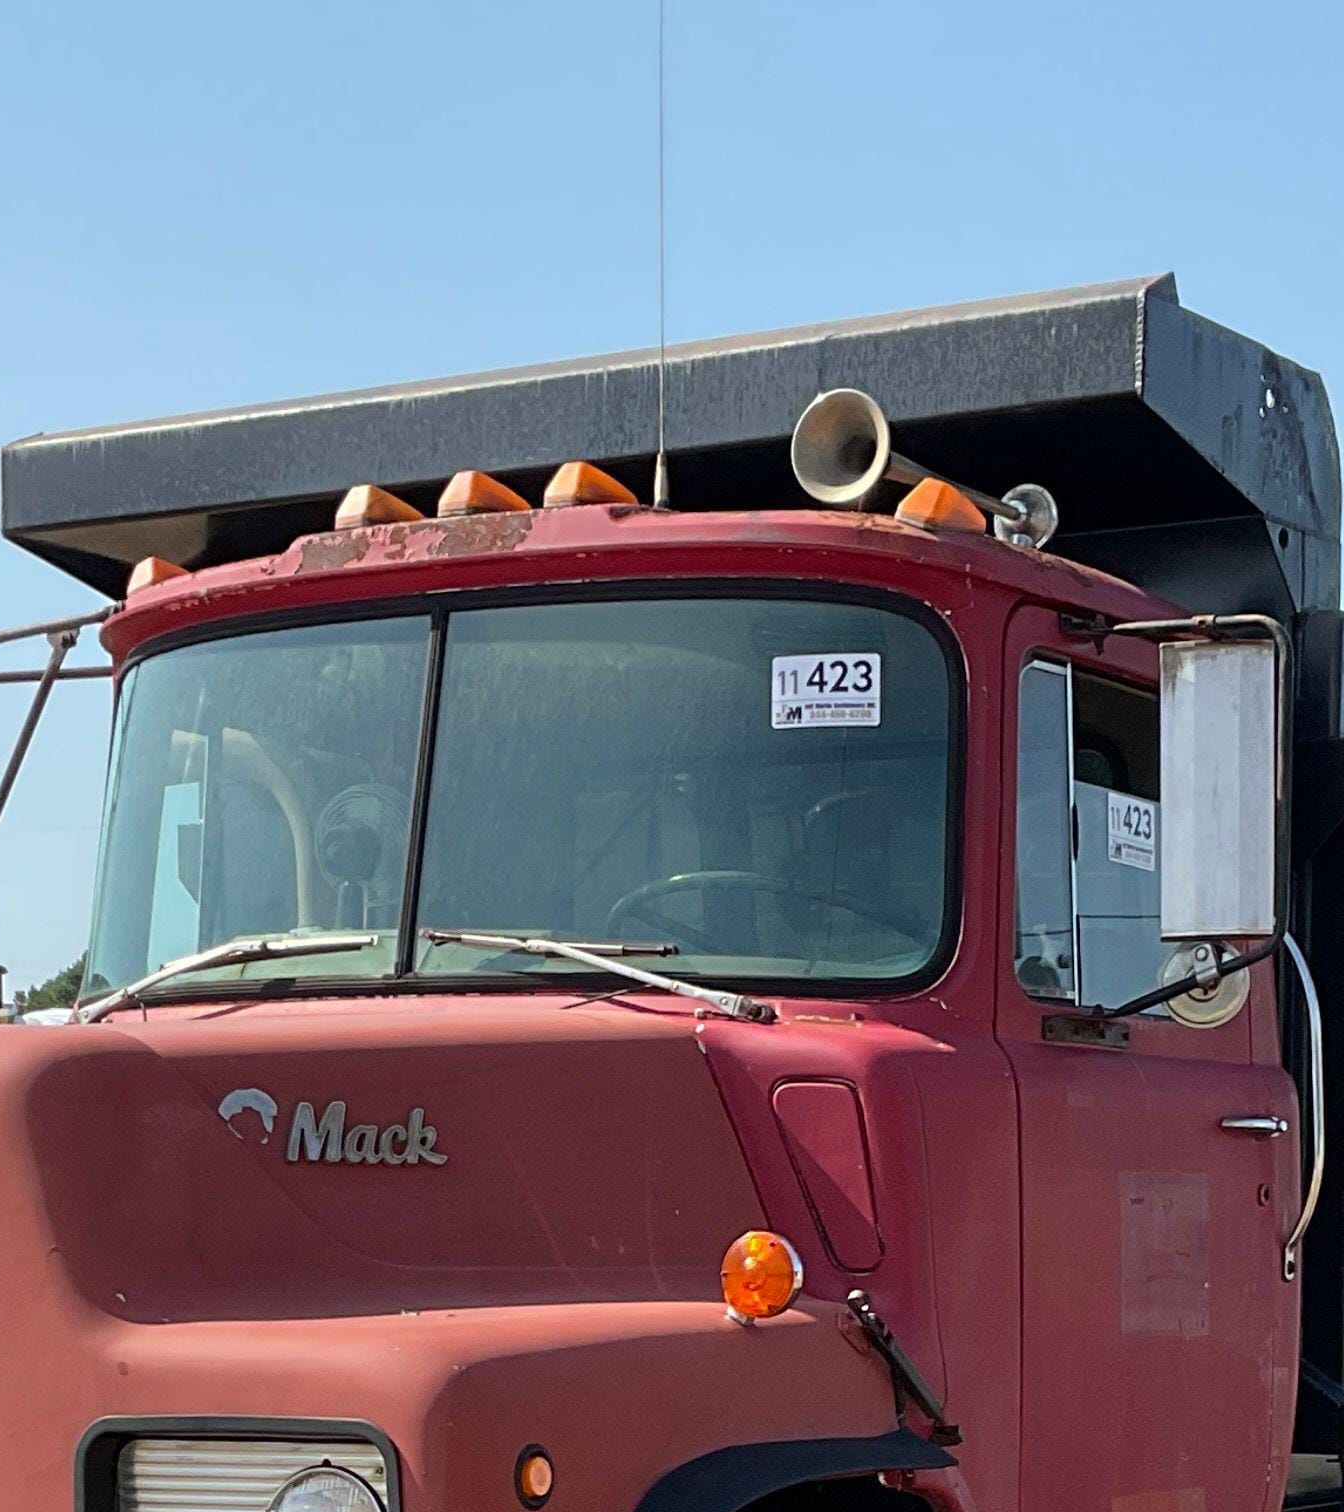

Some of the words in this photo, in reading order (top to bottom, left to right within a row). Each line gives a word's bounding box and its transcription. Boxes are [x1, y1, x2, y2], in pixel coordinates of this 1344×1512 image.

[806, 660, 873, 693] 423
[1123, 804, 1152, 840] 423
[286, 1101, 448, 1165] Mack
